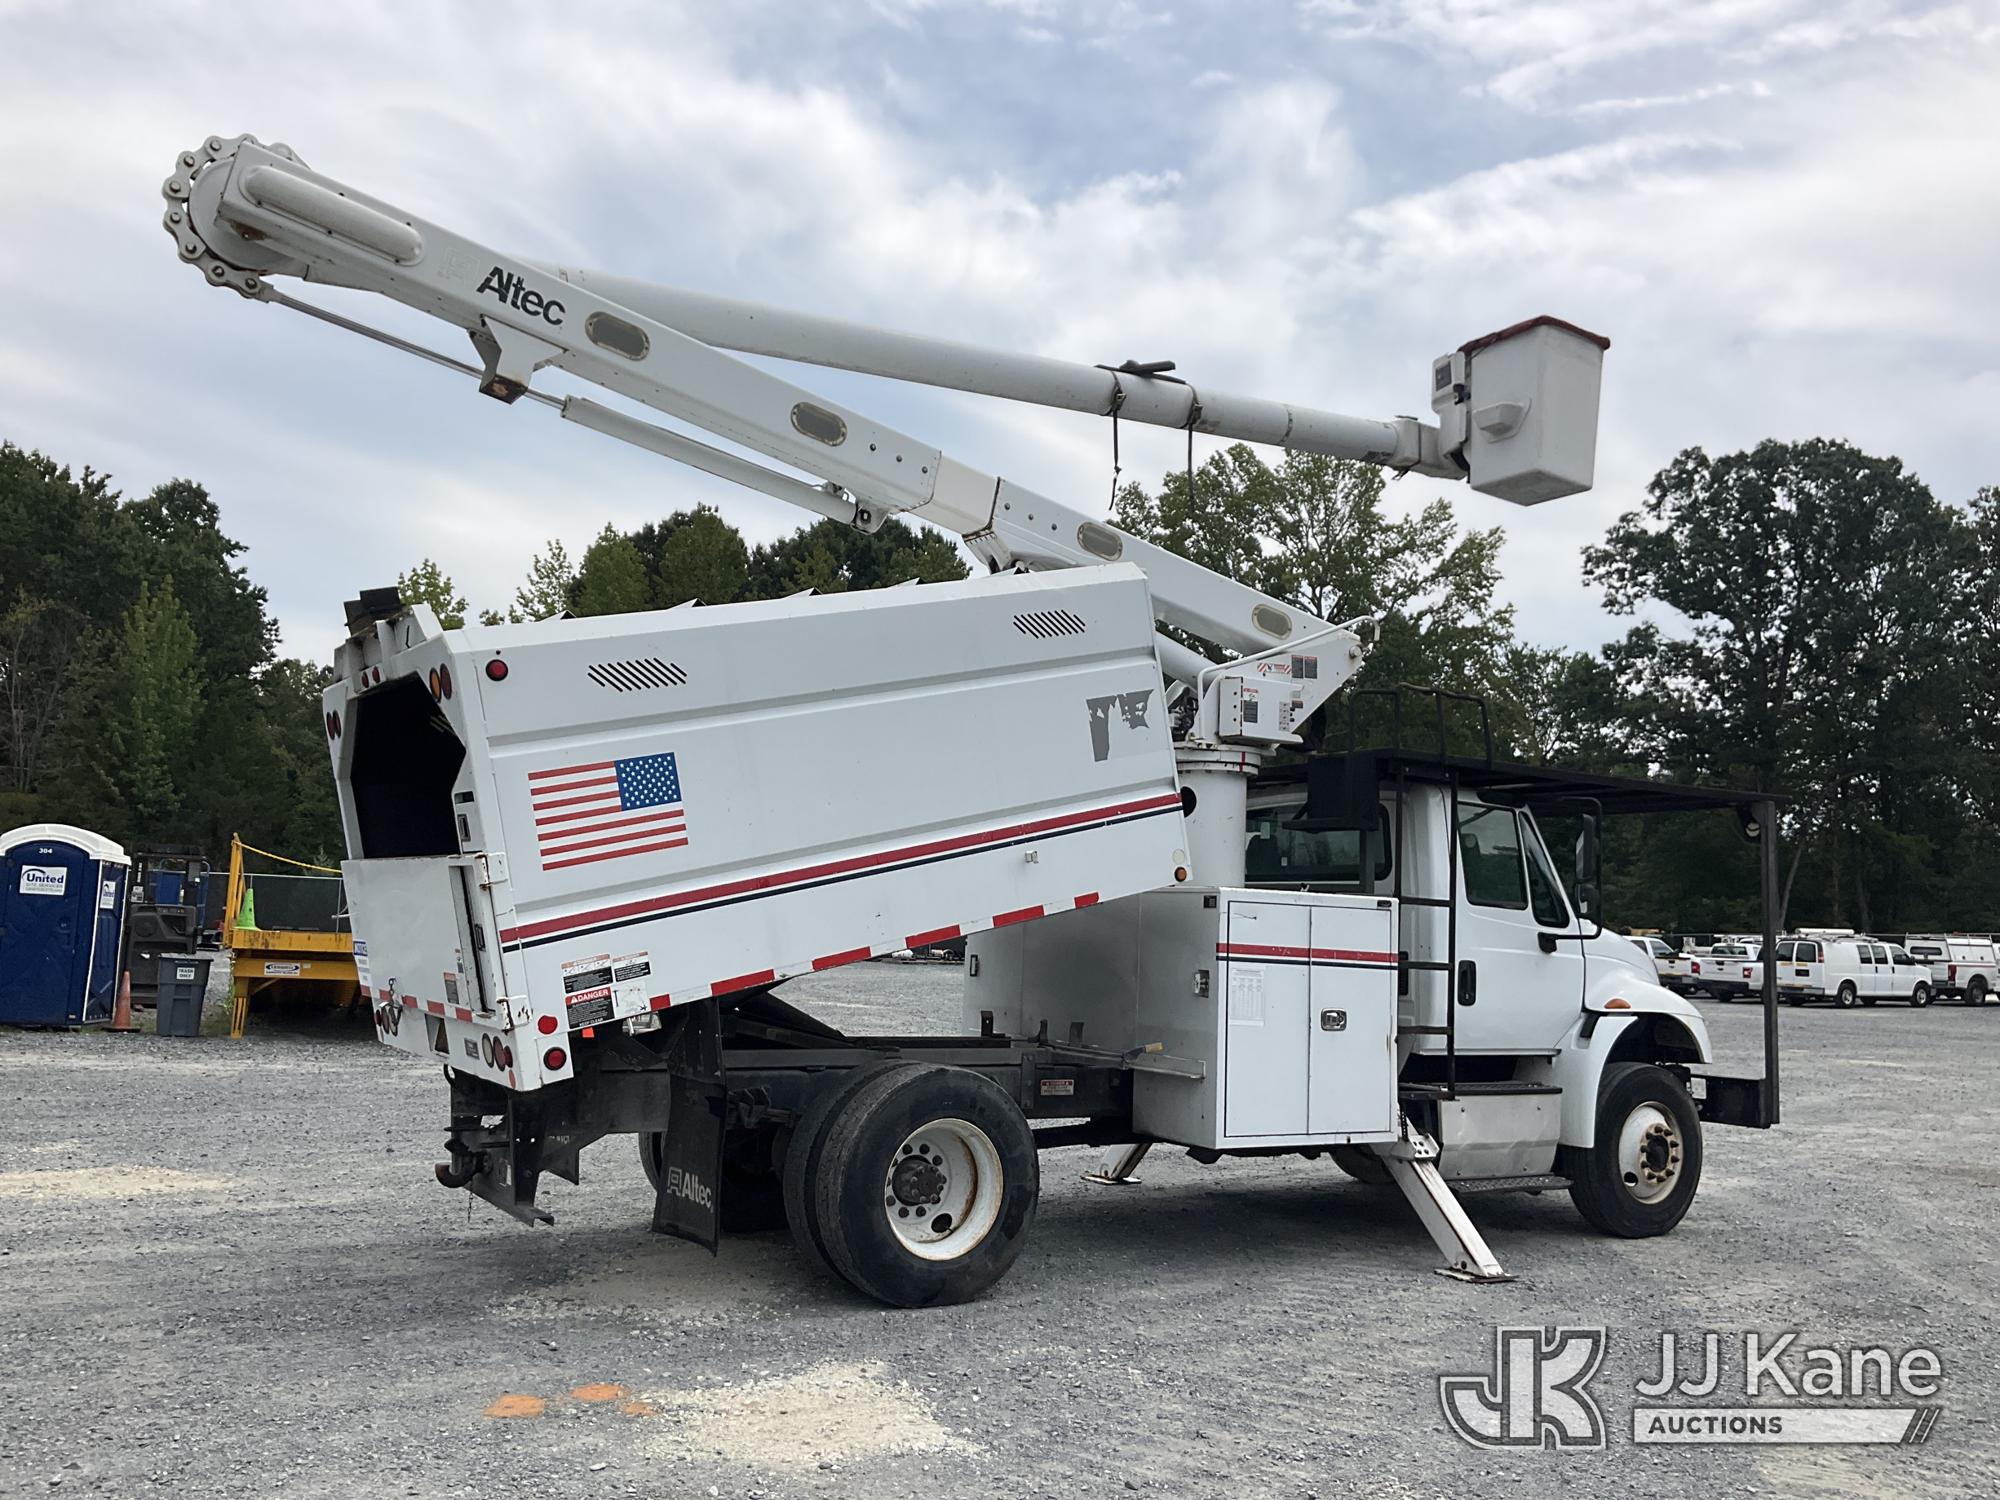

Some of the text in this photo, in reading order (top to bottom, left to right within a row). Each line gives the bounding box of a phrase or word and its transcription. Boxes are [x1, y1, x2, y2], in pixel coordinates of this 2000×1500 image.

[476, 265, 566, 326] Altec
[26, 873, 64, 884] United
[577, 988, 609, 1002] DANGER
[681, 1171, 712, 1209] Altec
